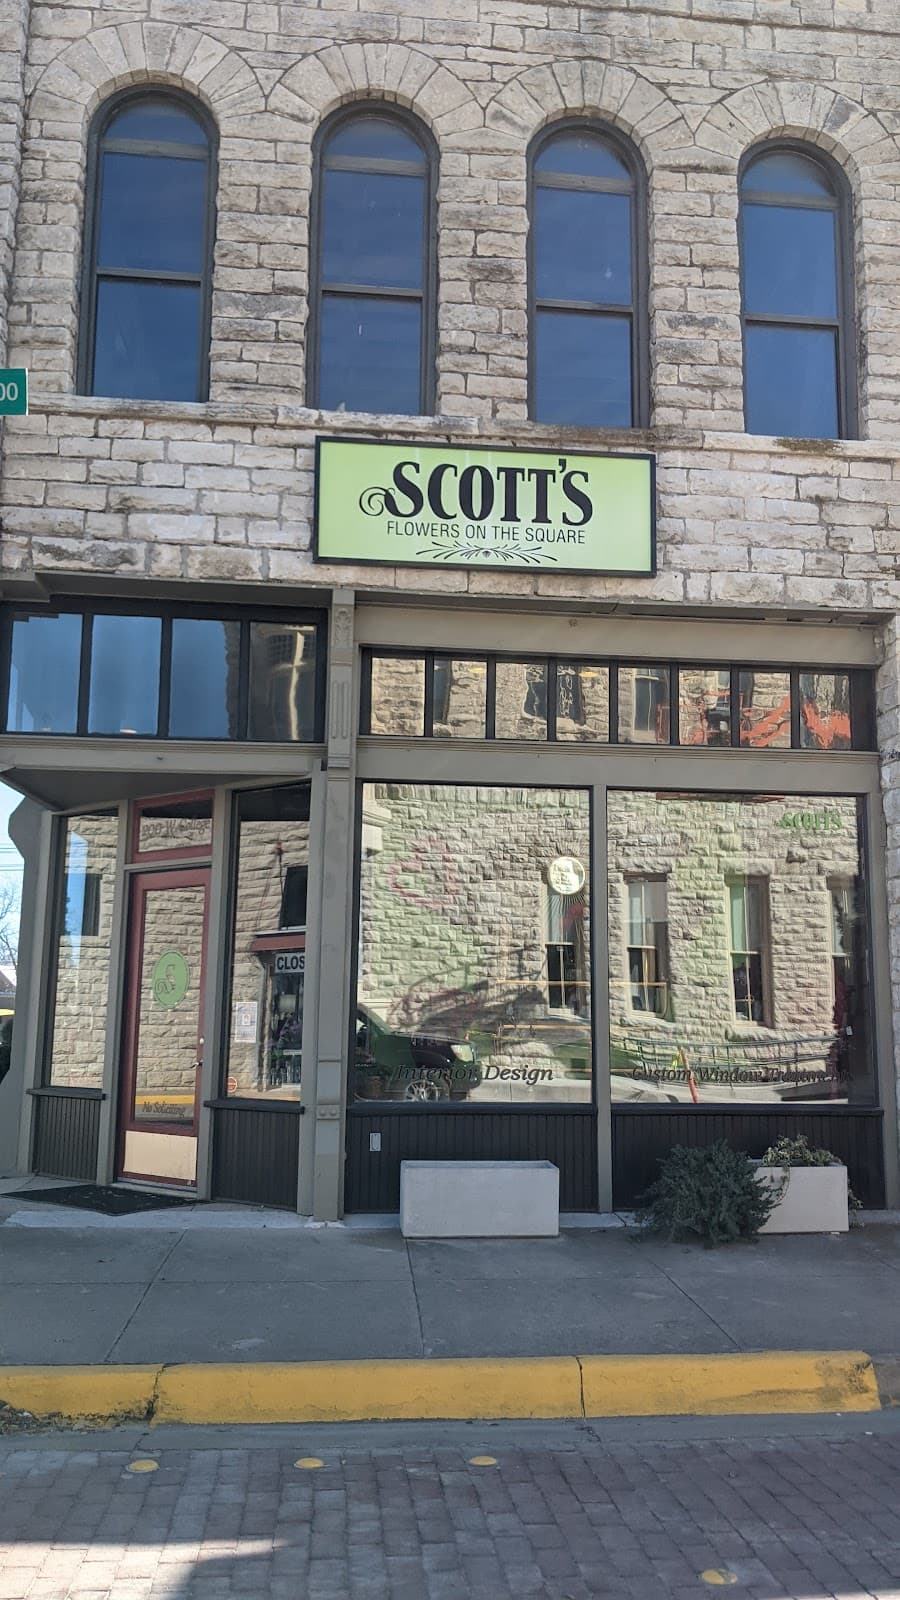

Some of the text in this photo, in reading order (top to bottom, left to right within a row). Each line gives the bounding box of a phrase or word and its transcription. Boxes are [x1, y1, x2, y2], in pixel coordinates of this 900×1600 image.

[359, 458, 594, 526] SCOTT'S
[387, 520, 586, 545] FLOWERS ON THE SQUARE
[398, 1064, 554, 1086] Interior Design
[631, 1067, 692, 1082] Custom
[698, 1066, 763, 1082] Window
[142, 1101, 153, 1113] No
